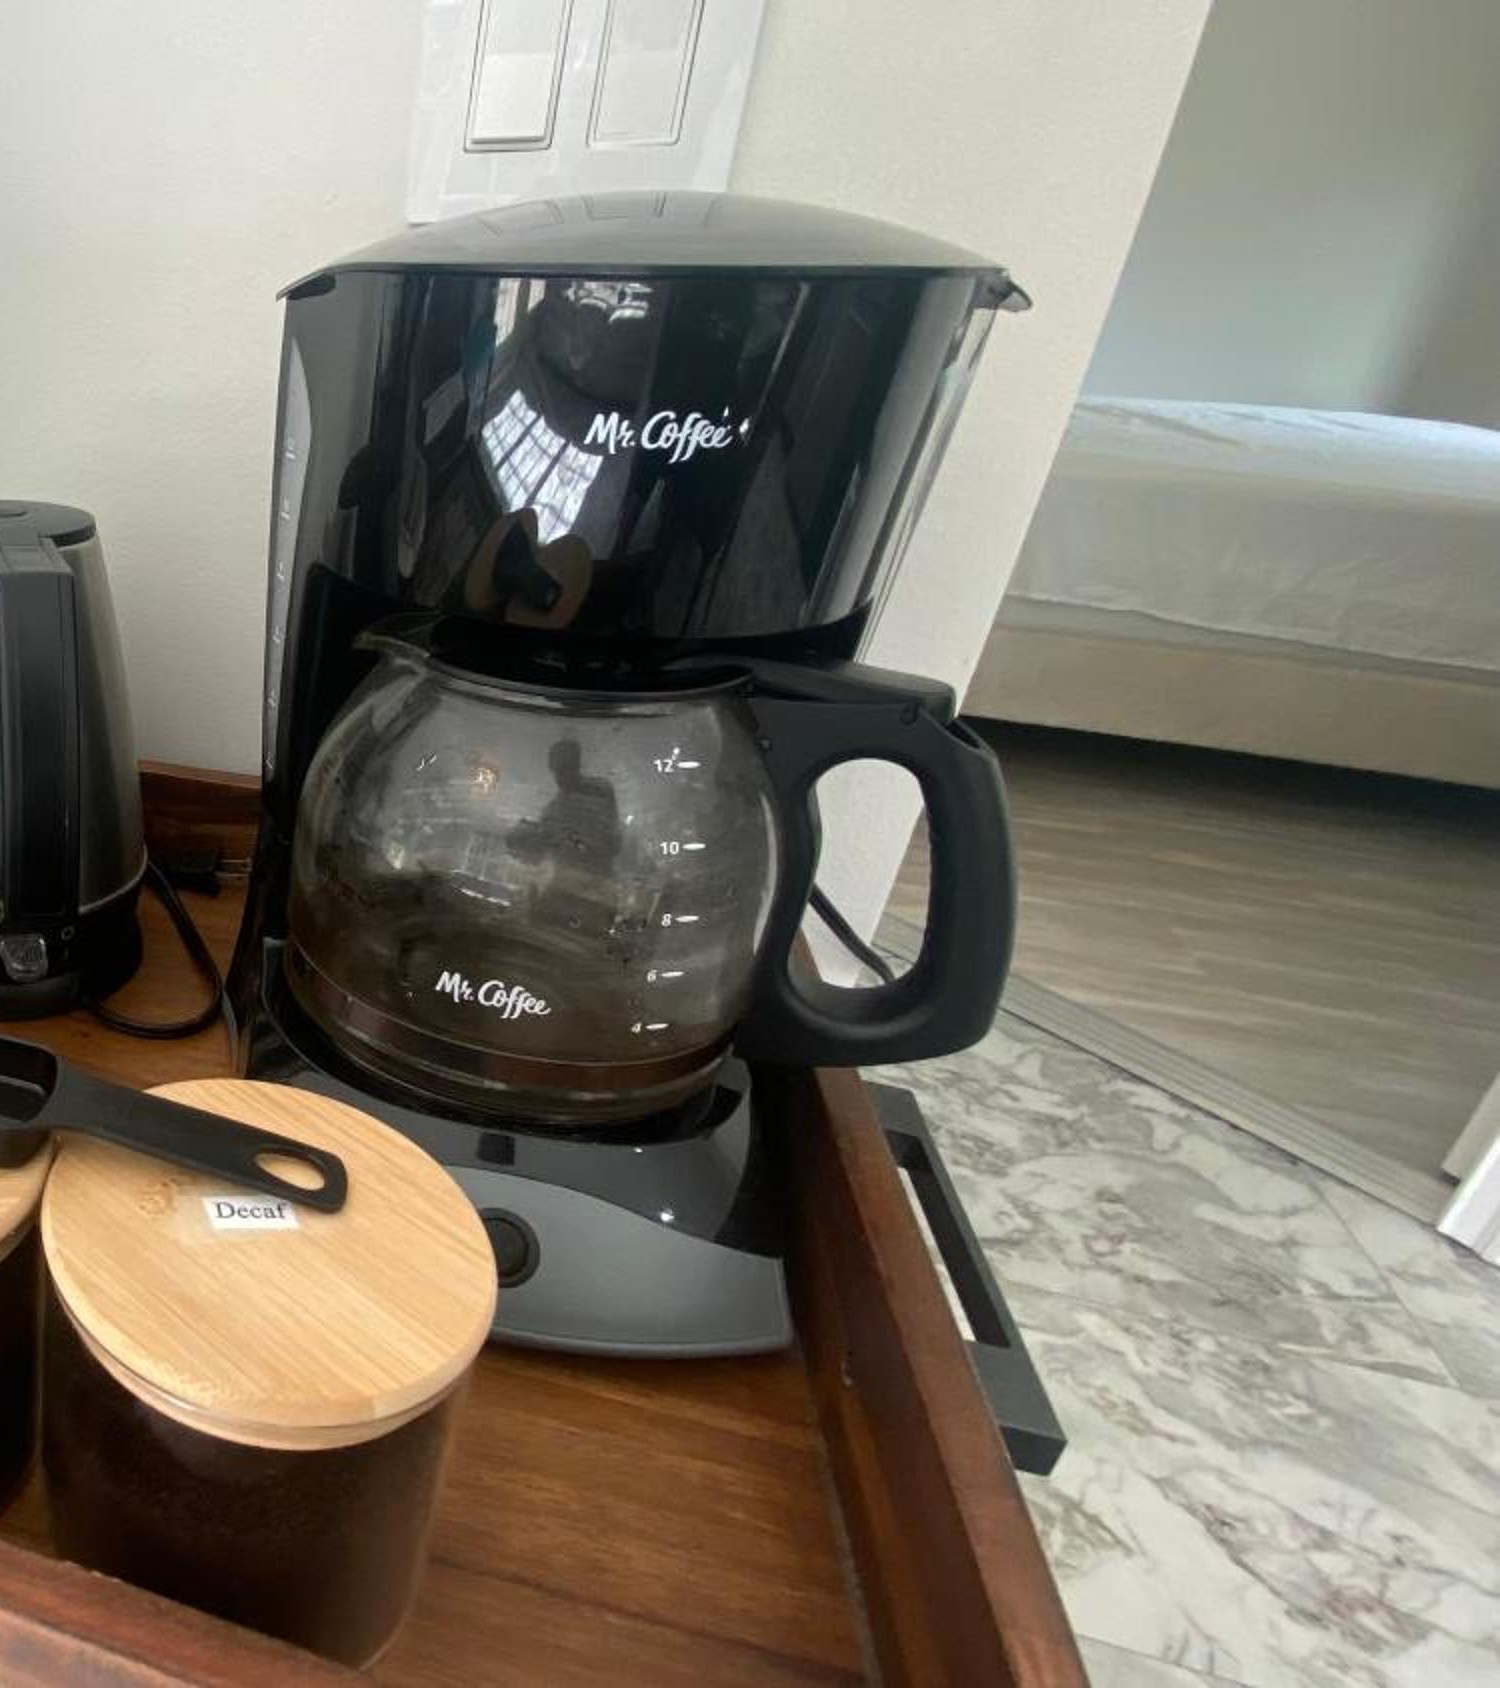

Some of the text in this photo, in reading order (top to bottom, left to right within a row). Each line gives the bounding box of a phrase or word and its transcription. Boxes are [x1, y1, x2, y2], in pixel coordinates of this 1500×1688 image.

[583, 410, 732, 465] Mr. Coffee
[654, 759, 674, 773] 12
[660, 841, 679, 855] 10
[661, 913, 671, 927] 8
[647, 970, 657, 983] 6
[435, 971, 552, 1019] Mr. Coffee
[631, 1022, 642, 1034] 4
[213, 1201, 286, 1219] Decaf
